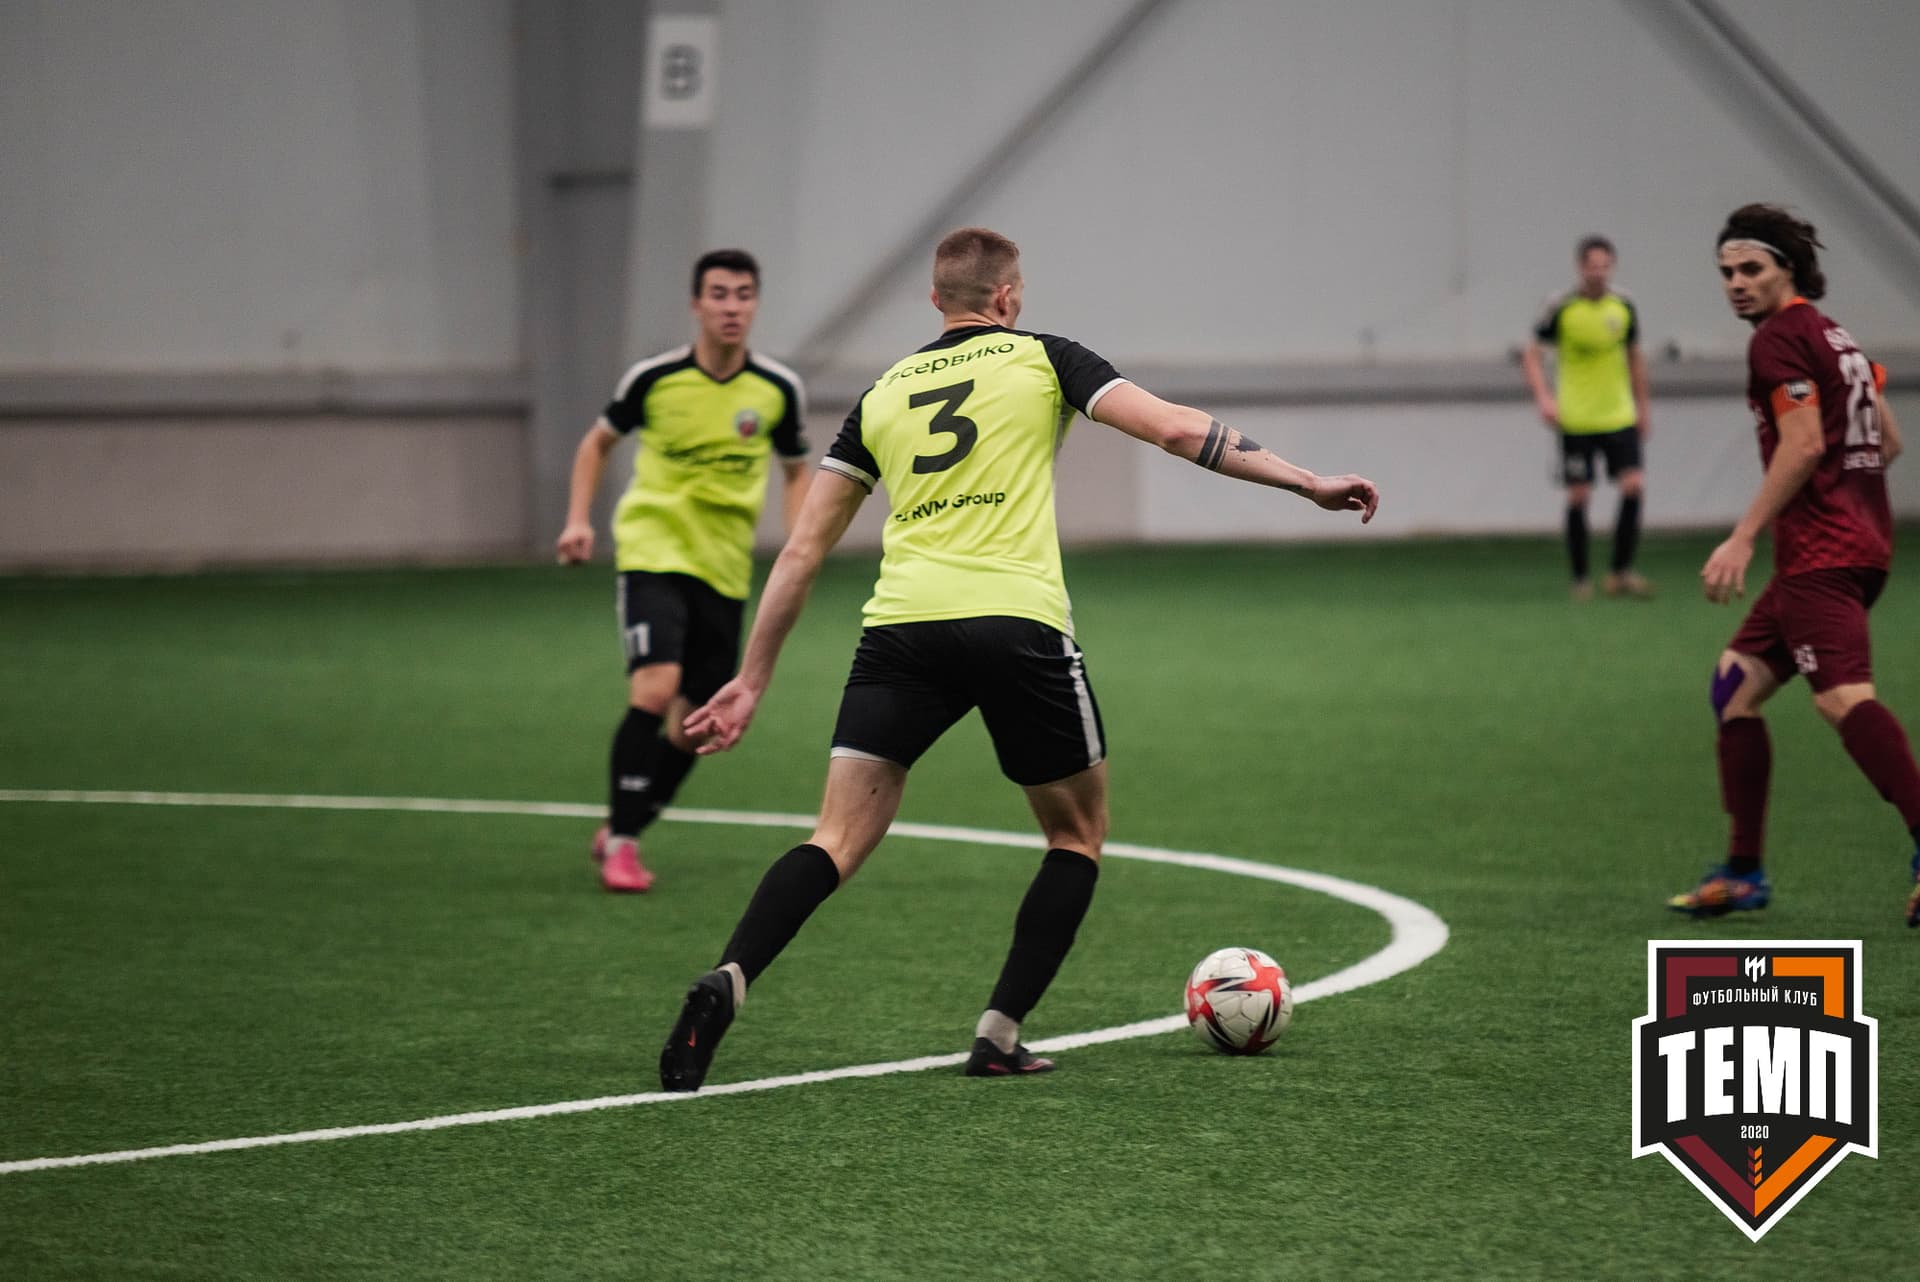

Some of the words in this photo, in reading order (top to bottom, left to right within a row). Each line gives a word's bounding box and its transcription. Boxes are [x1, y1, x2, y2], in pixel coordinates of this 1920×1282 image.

[908, 378, 979, 475] 3
[911, 498, 948, 521] RVM
[951, 491, 1006, 509] Group
